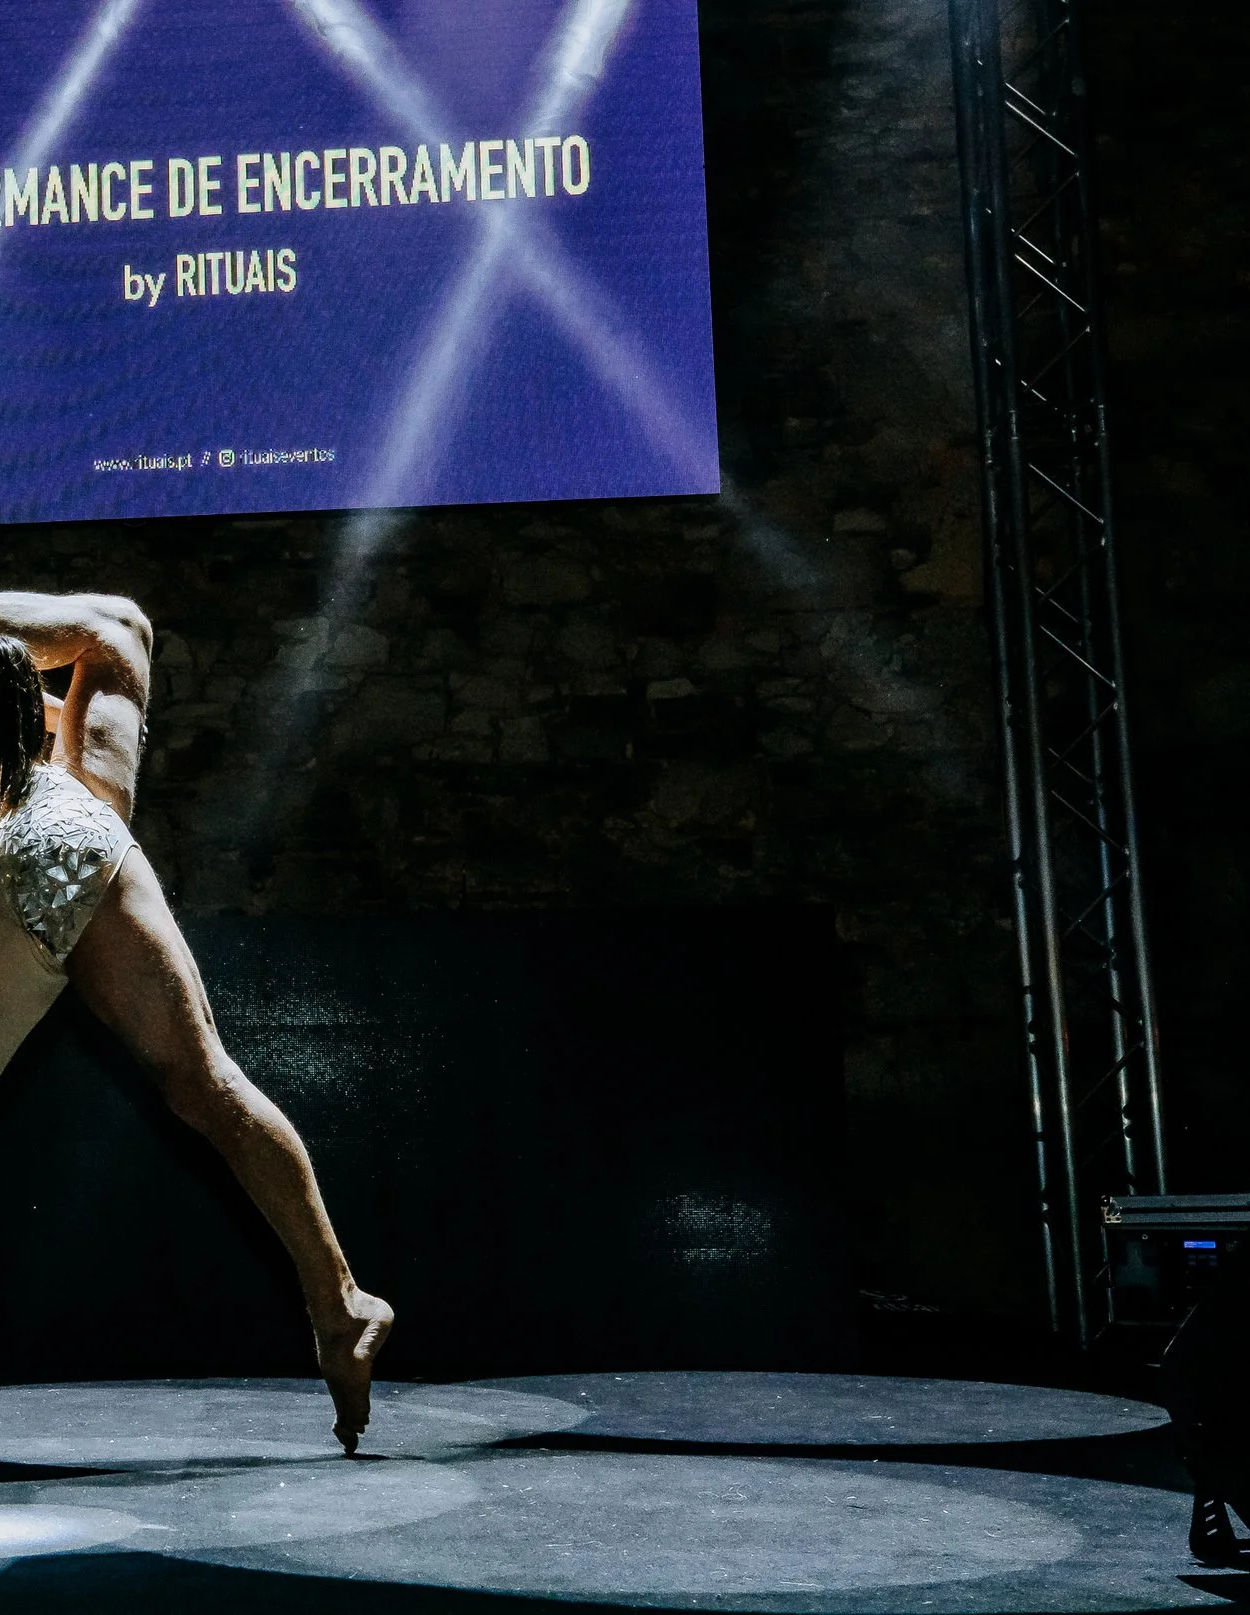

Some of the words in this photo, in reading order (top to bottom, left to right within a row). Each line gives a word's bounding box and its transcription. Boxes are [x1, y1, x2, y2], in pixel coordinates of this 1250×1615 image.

[168, 156, 222, 217] DE
[237, 135, 591, 214] ENCERRAMENTO
[124, 264, 167, 307] by
[176, 249, 298, 297] RITUAIS
